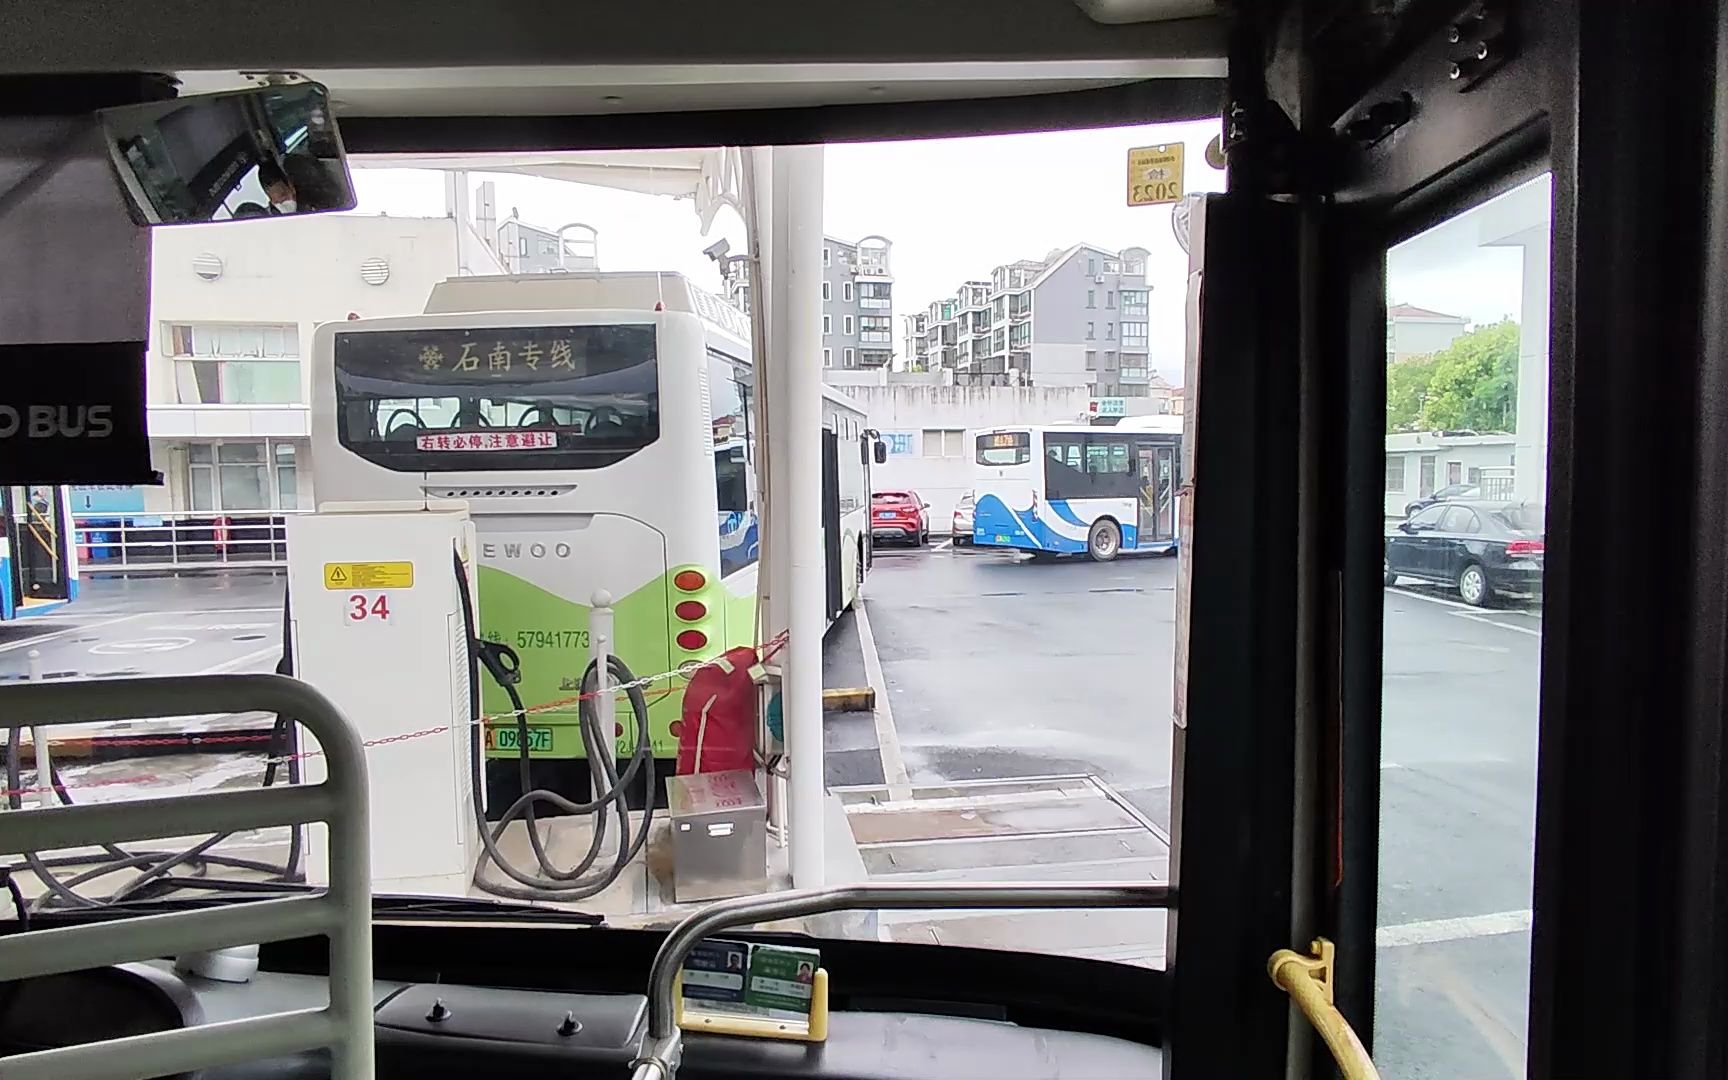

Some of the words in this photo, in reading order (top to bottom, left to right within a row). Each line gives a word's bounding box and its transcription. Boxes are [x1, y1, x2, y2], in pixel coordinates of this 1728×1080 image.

[452, 339, 576, 372] 石南专线
[28, 405, 113, 438] BUS
[349, 594, 390, 620] 34
[516, 630, 590, 649] 57941773
